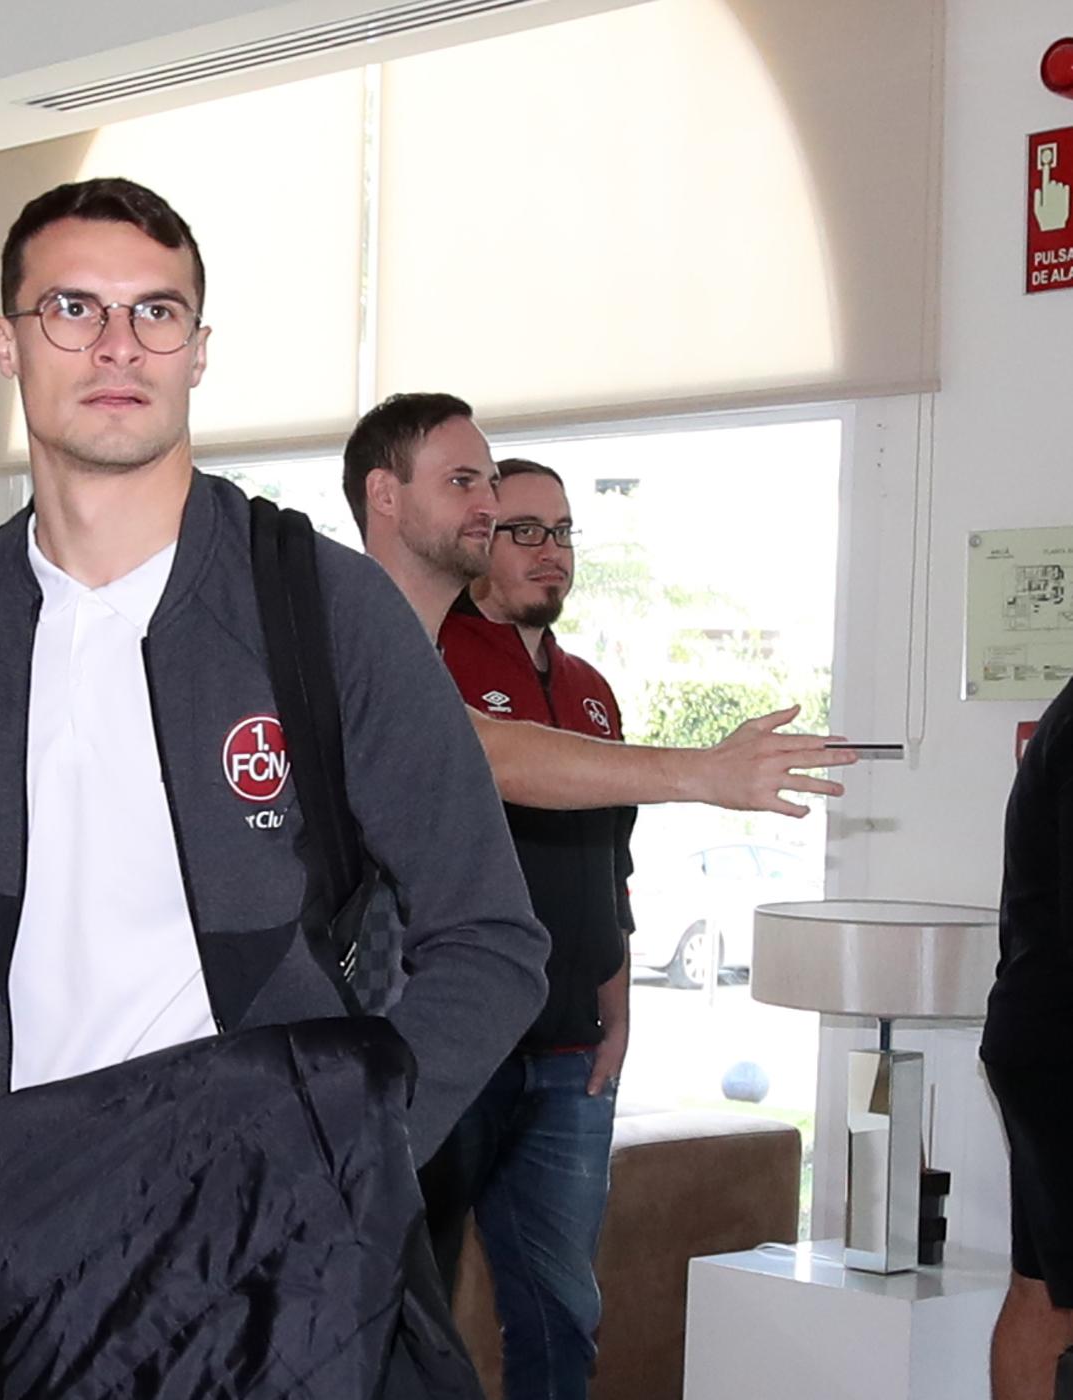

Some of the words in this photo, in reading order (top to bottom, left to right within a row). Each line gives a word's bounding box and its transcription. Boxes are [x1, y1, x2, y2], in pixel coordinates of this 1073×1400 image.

[1032, 270, 1048, 286] DE
[251, 723, 270, 751] 1.
[232, 750, 286, 782] FCN
[256, 809, 285, 829] Clu
